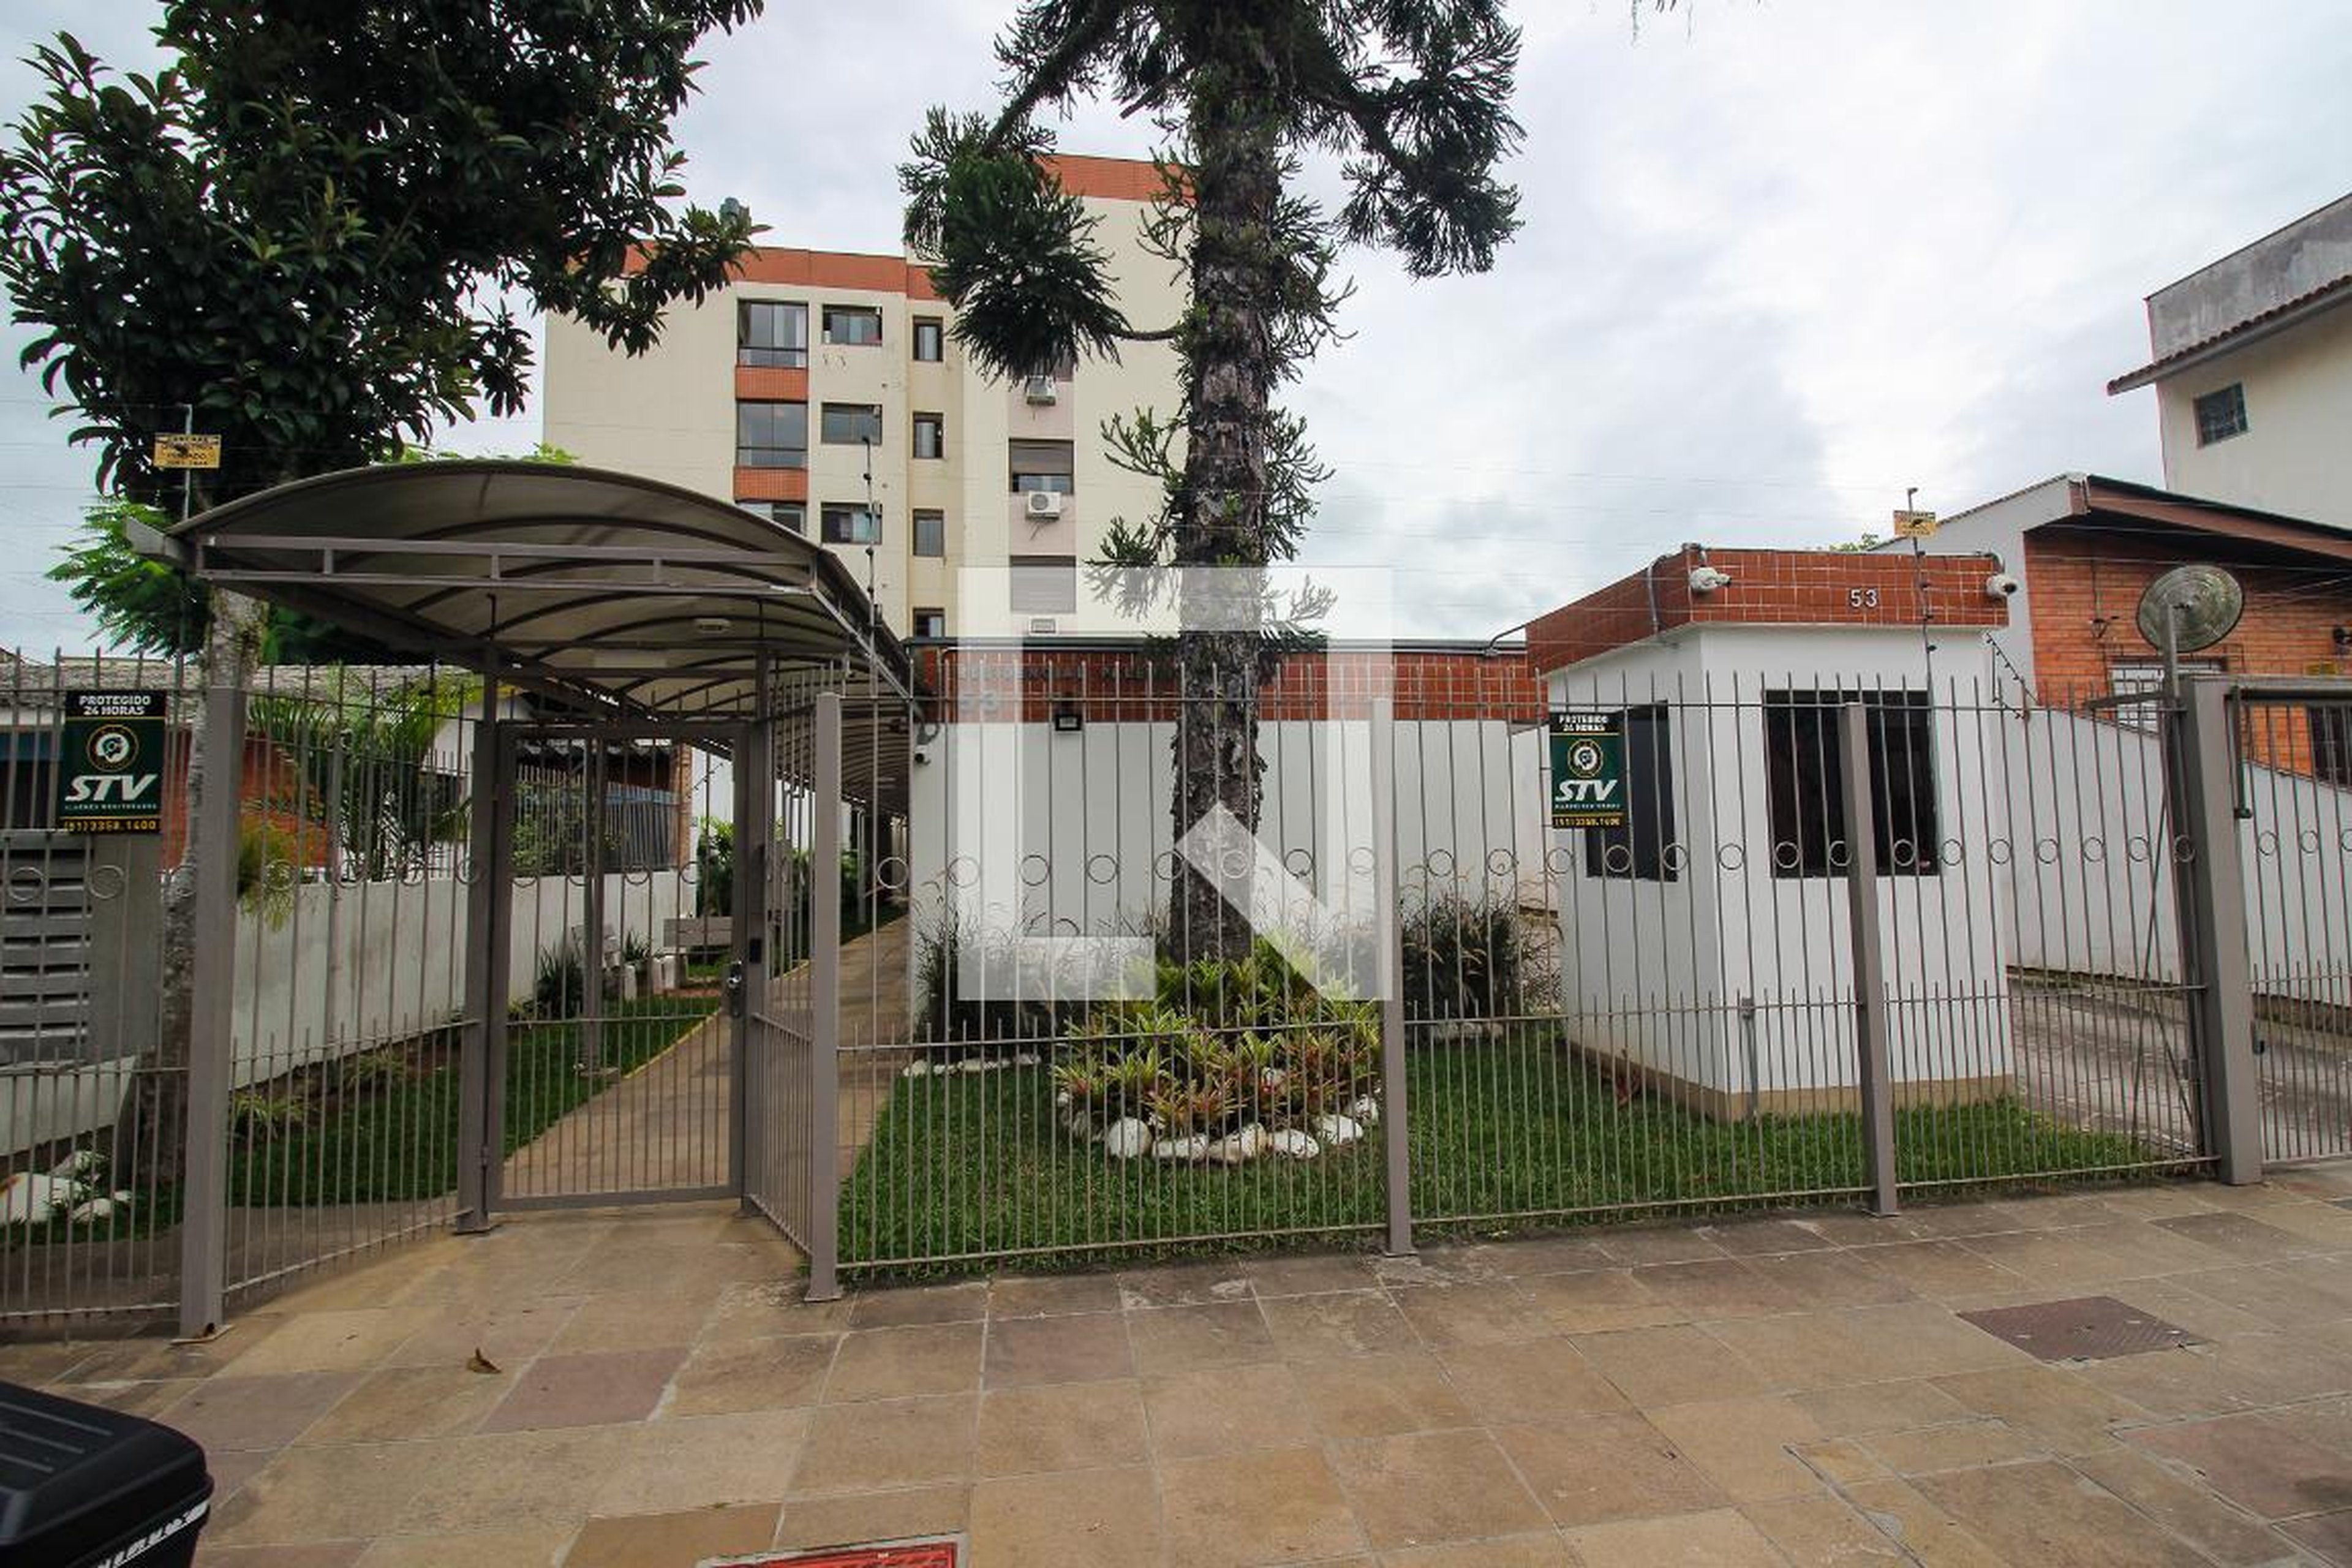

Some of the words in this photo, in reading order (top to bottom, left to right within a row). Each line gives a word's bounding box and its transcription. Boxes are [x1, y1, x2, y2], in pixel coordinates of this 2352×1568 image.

[1850, 589, 1877, 608] 53
[79, 695, 151, 705] PROTEGIDO
[101, 706, 145, 715] HORAS
[64, 774, 158, 801] STV
[1555, 779, 1618, 801] STV
